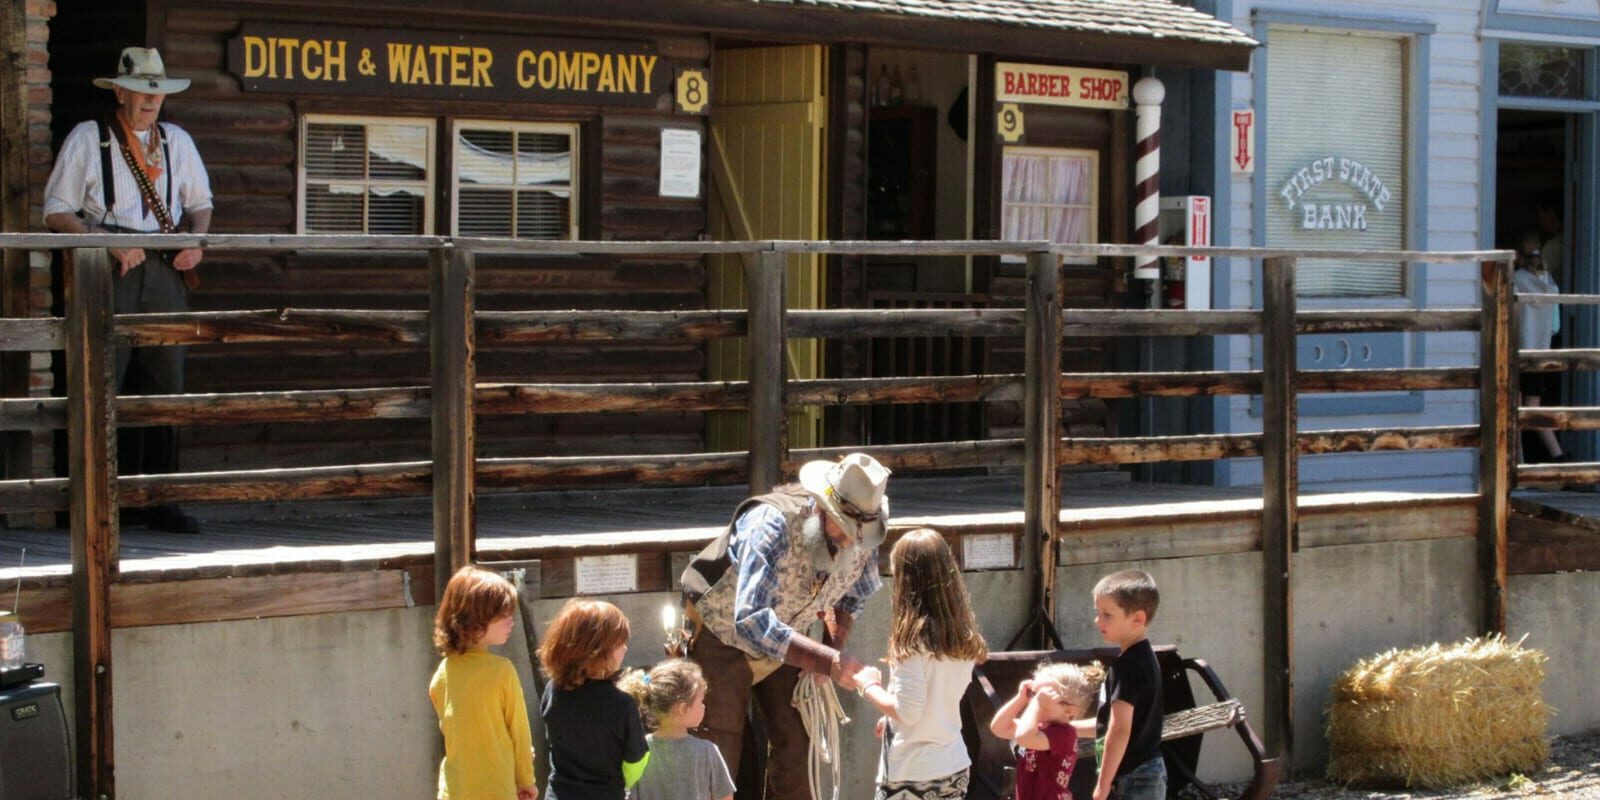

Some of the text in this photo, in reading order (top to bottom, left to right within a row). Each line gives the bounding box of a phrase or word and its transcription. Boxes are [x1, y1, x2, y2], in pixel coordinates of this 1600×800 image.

[243, 36, 658, 95] DITCH & WATER COMPANY
[686, 77, 702, 105] 8
[1003, 71, 1122, 101] BARBER SHOP
[1003, 109, 1016, 132] 9
[1281, 157, 1392, 212] FIRST STATE
[1302, 203, 1368, 231] BANK
